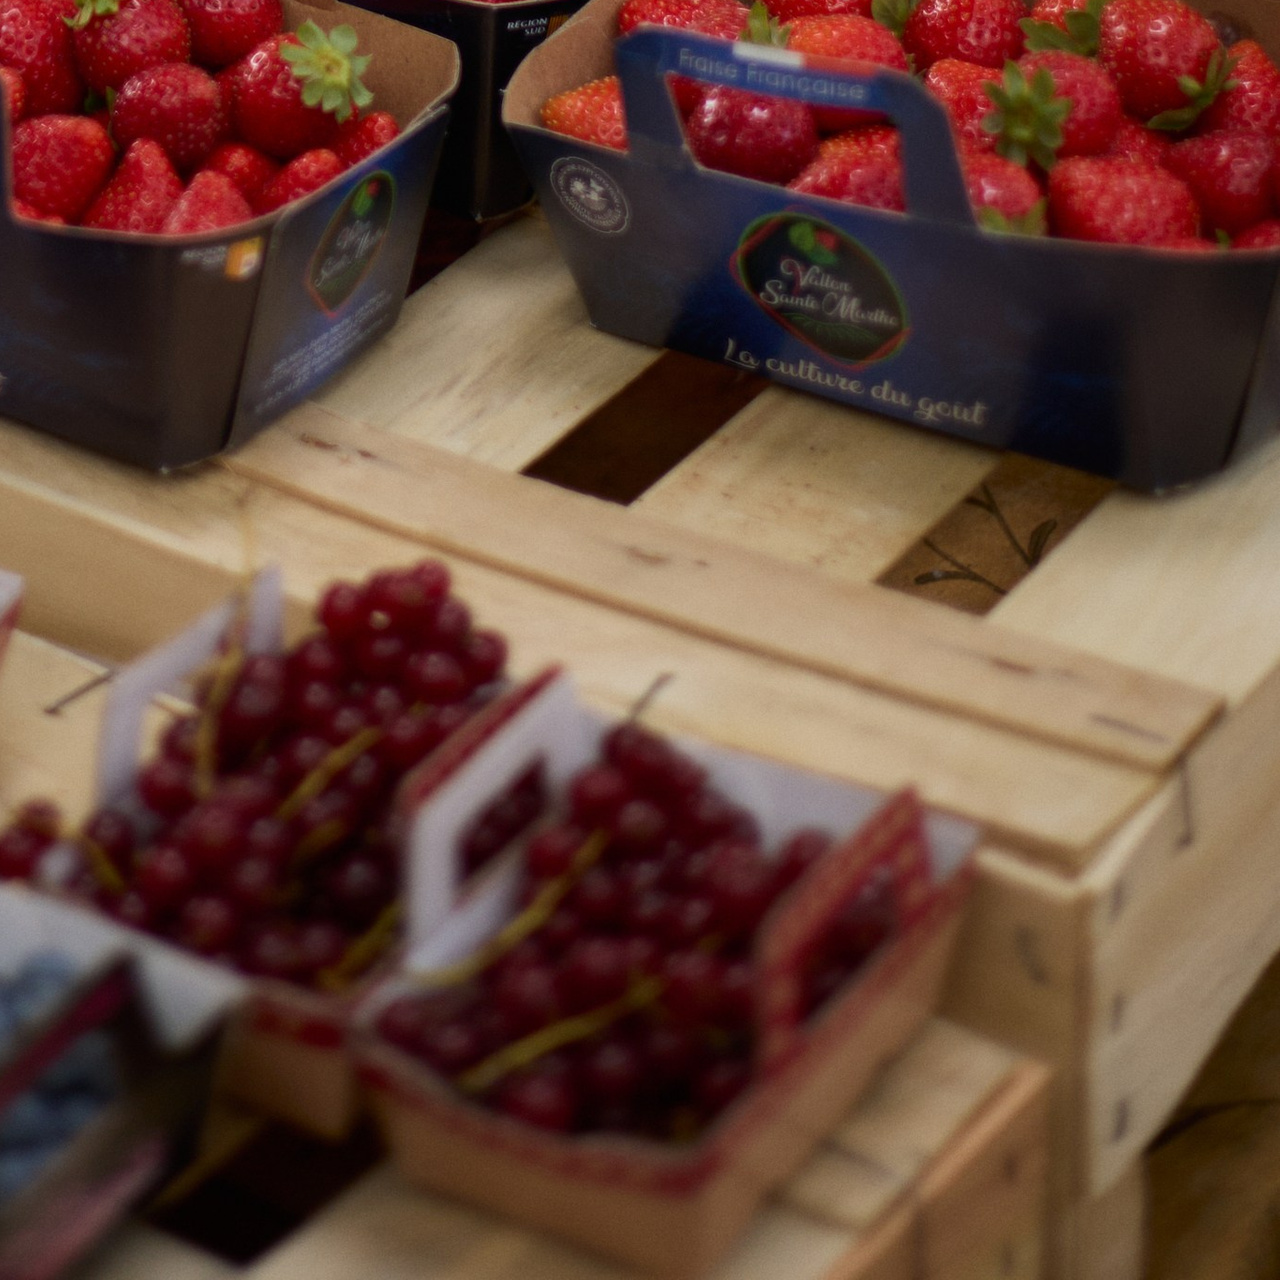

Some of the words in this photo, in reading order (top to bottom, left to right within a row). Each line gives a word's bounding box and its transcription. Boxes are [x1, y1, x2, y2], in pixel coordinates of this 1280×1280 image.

[524, 26, 547, 37] SUD
[679, 47, 738, 79] Fraise
[746, 63, 866, 100] Française
[724, 337, 759, 369] La
[765, 357, 865, 395] culture
[870, 380, 911, 407] du
